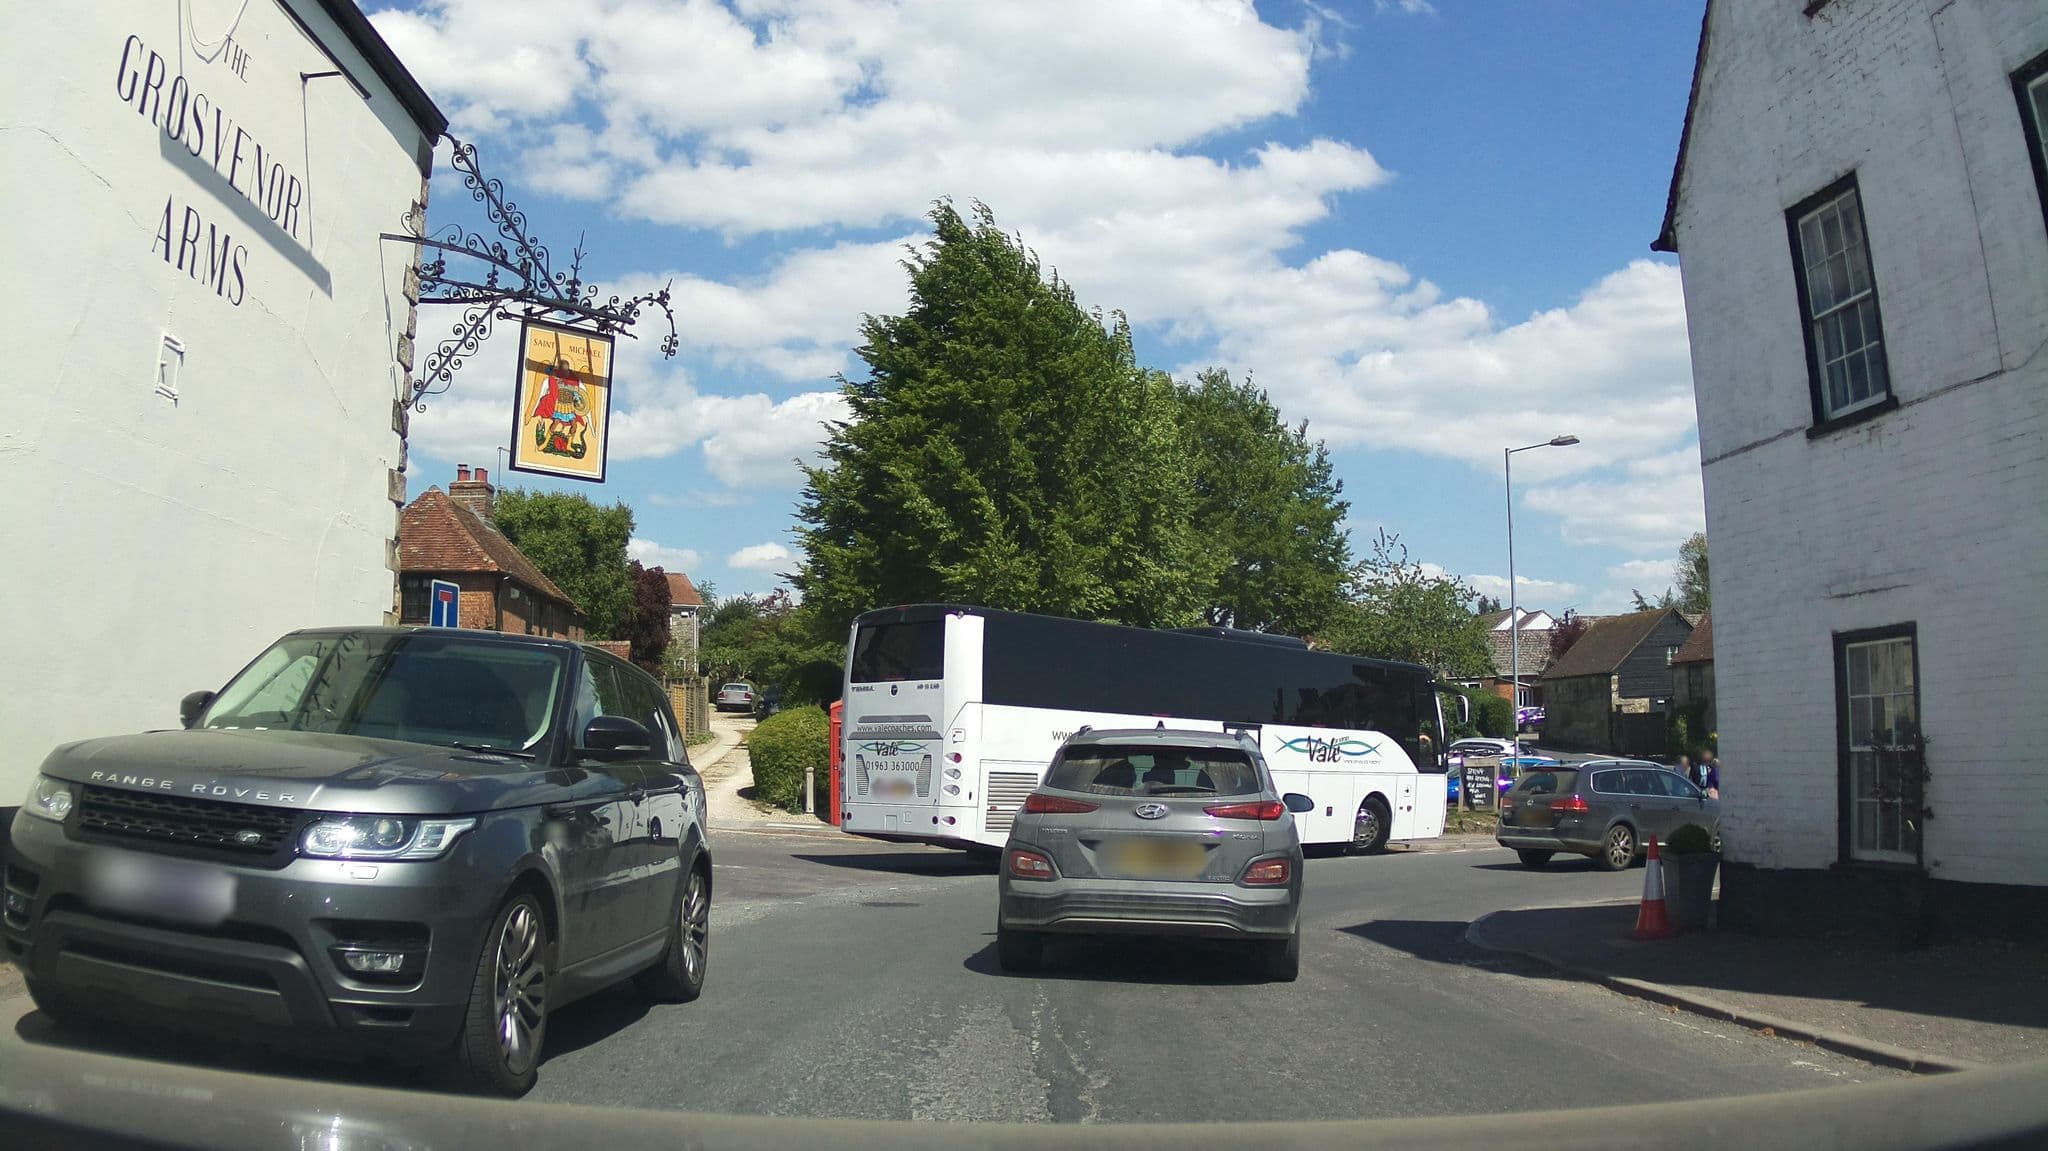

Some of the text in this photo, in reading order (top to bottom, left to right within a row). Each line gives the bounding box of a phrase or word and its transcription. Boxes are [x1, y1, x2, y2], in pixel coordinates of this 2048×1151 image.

[223, 34, 252, 84] THE
[117, 34, 302, 240] GROSVENOR
[151, 193, 248, 306] ARMS
[533, 338, 555, 350] SAINT
[857, 723, 932, 733] www.valecoaches.com
[875, 740, 899, 757] Vale
[1307, 735, 1341, 763] Vale
[866, 760, 920, 772] 01963 363000
[91, 770, 296, 802] RANGE ROVER
